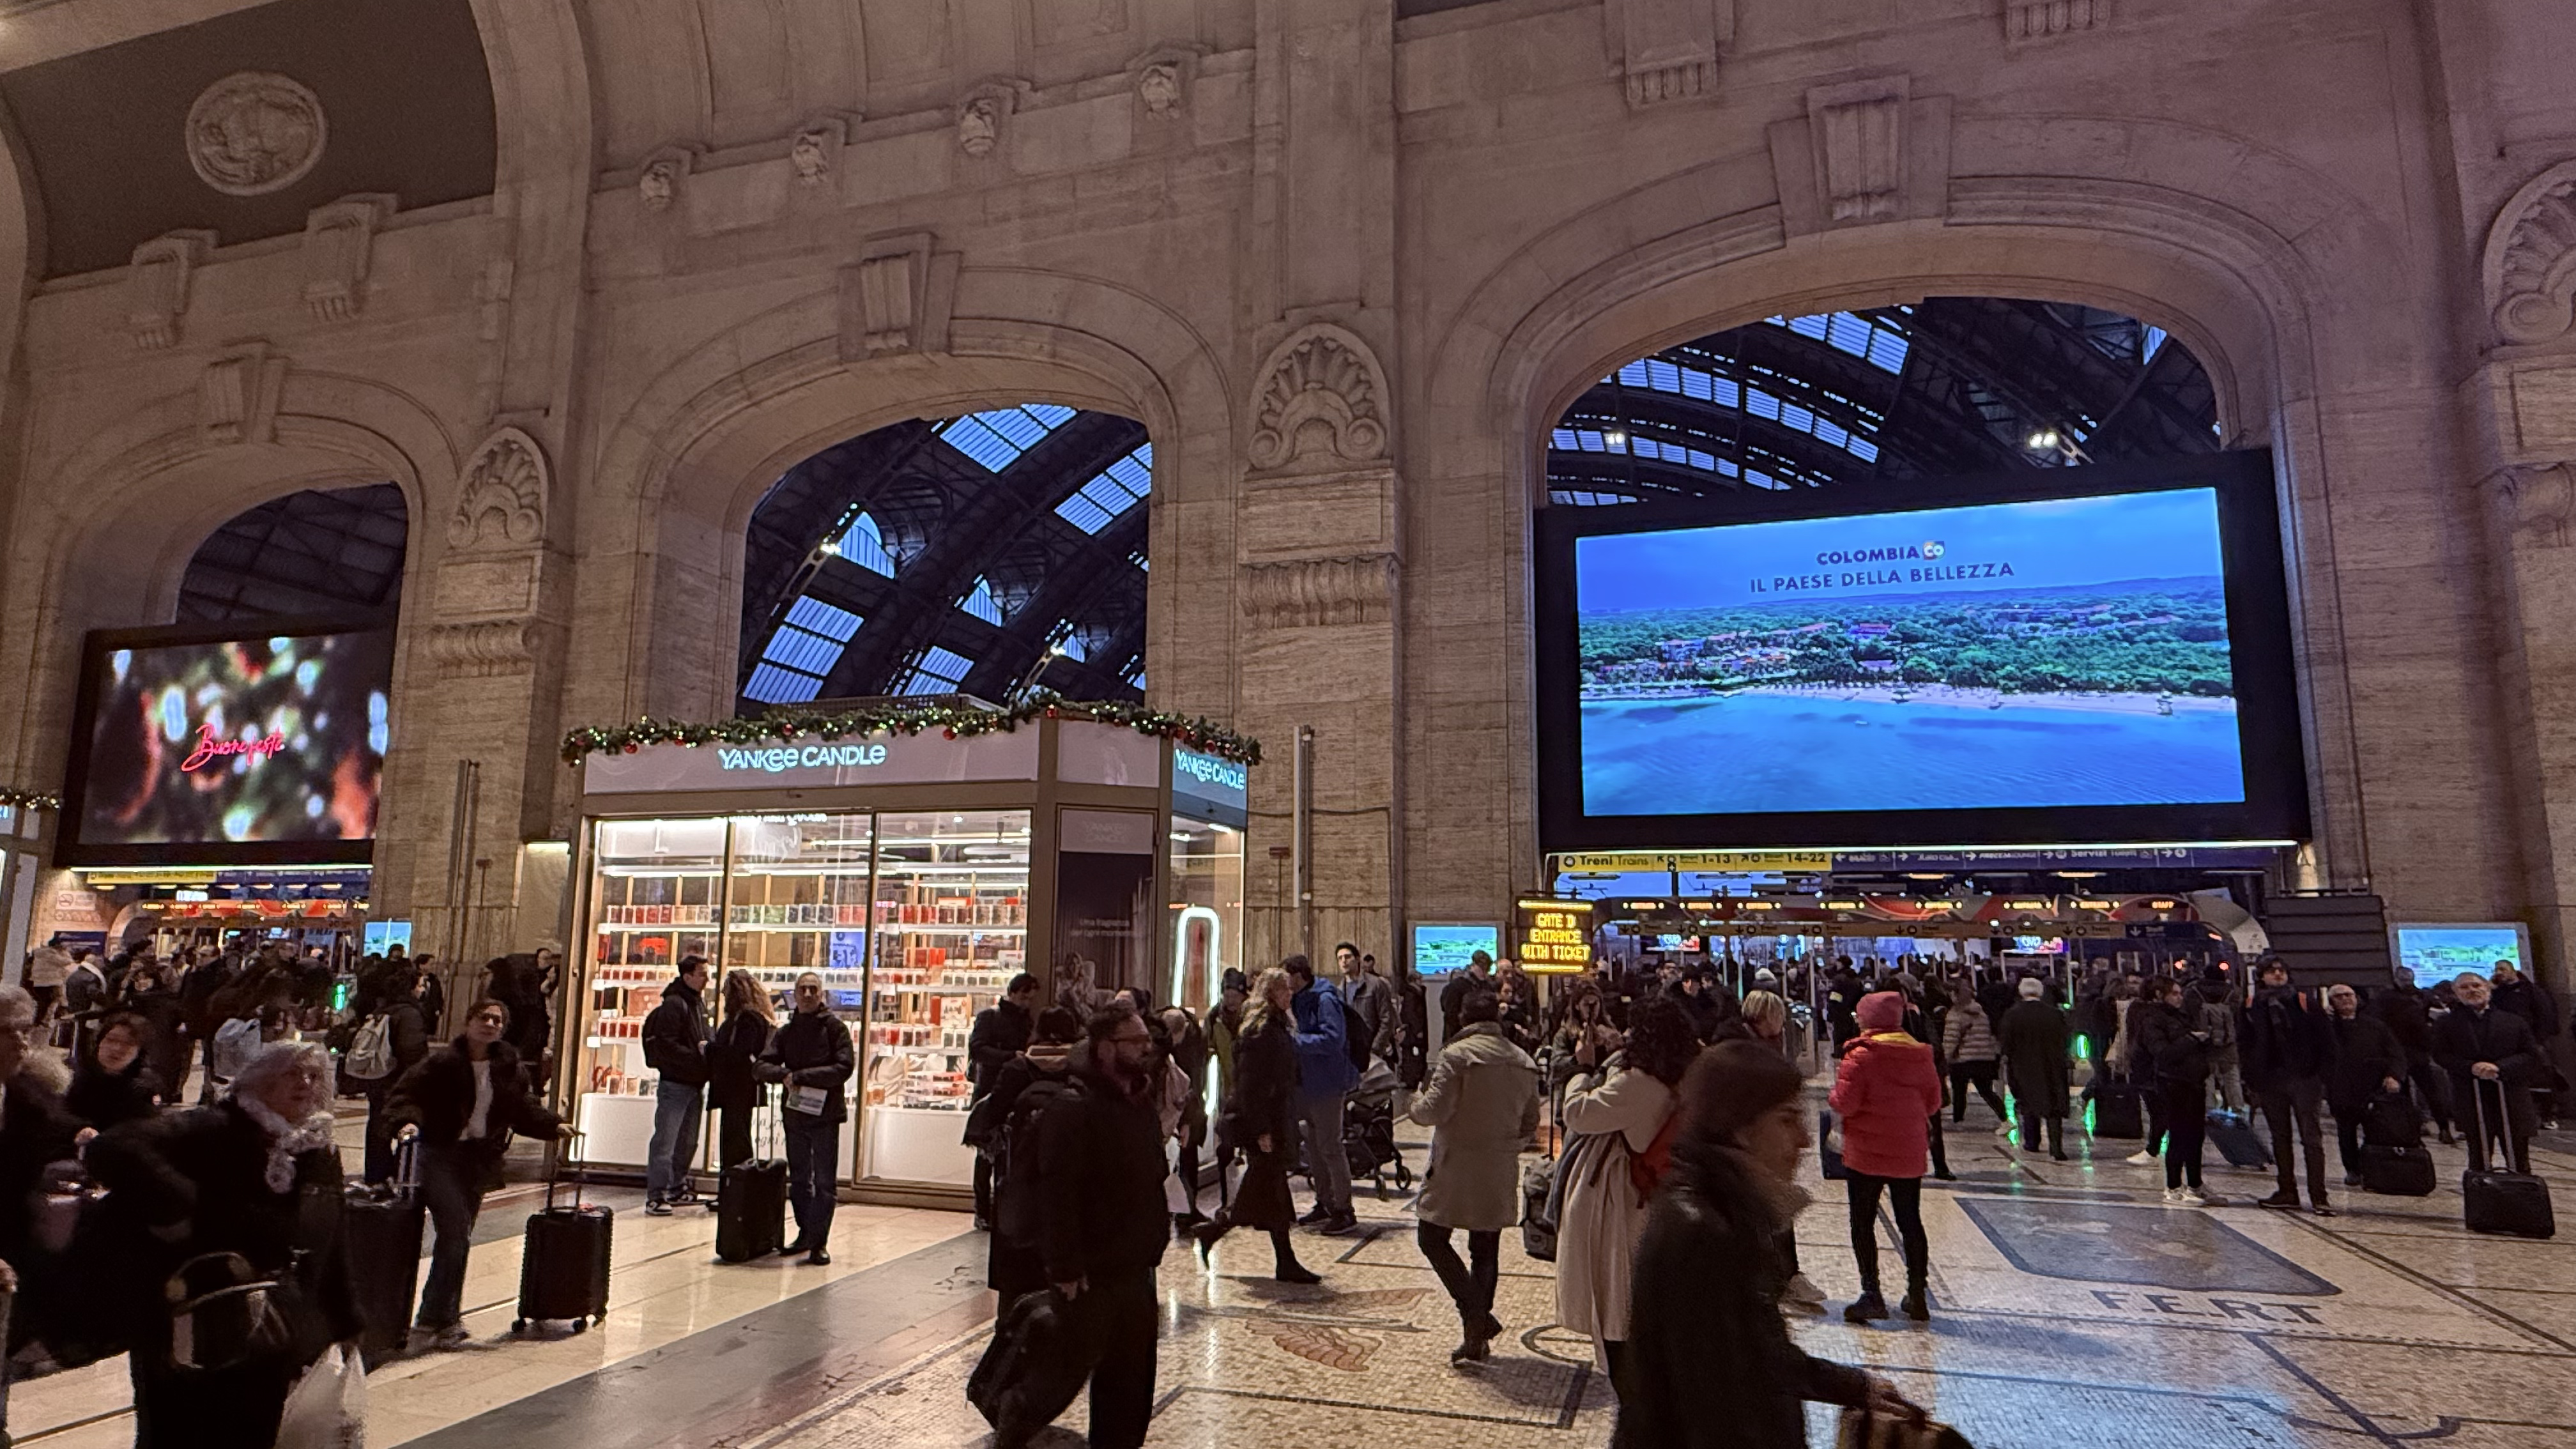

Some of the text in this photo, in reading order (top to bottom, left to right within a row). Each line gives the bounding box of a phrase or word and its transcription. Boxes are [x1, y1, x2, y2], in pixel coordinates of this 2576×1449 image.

[1816, 546, 1920, 565] COLOMBIA
[1751, 562, 2015, 593] IL PAESE DELLA BELLEZZA
[1579, 855, 1613, 866] Treni
[1702, 854, 1730, 864] 1-13
[1787, 853, 1827, 863] 14-22
[1536, 913, 1564, 928] GATE
[1530, 927, 1582, 944] ENTRANCE
[1521, 943, 1591, 961] WITH TICKET
